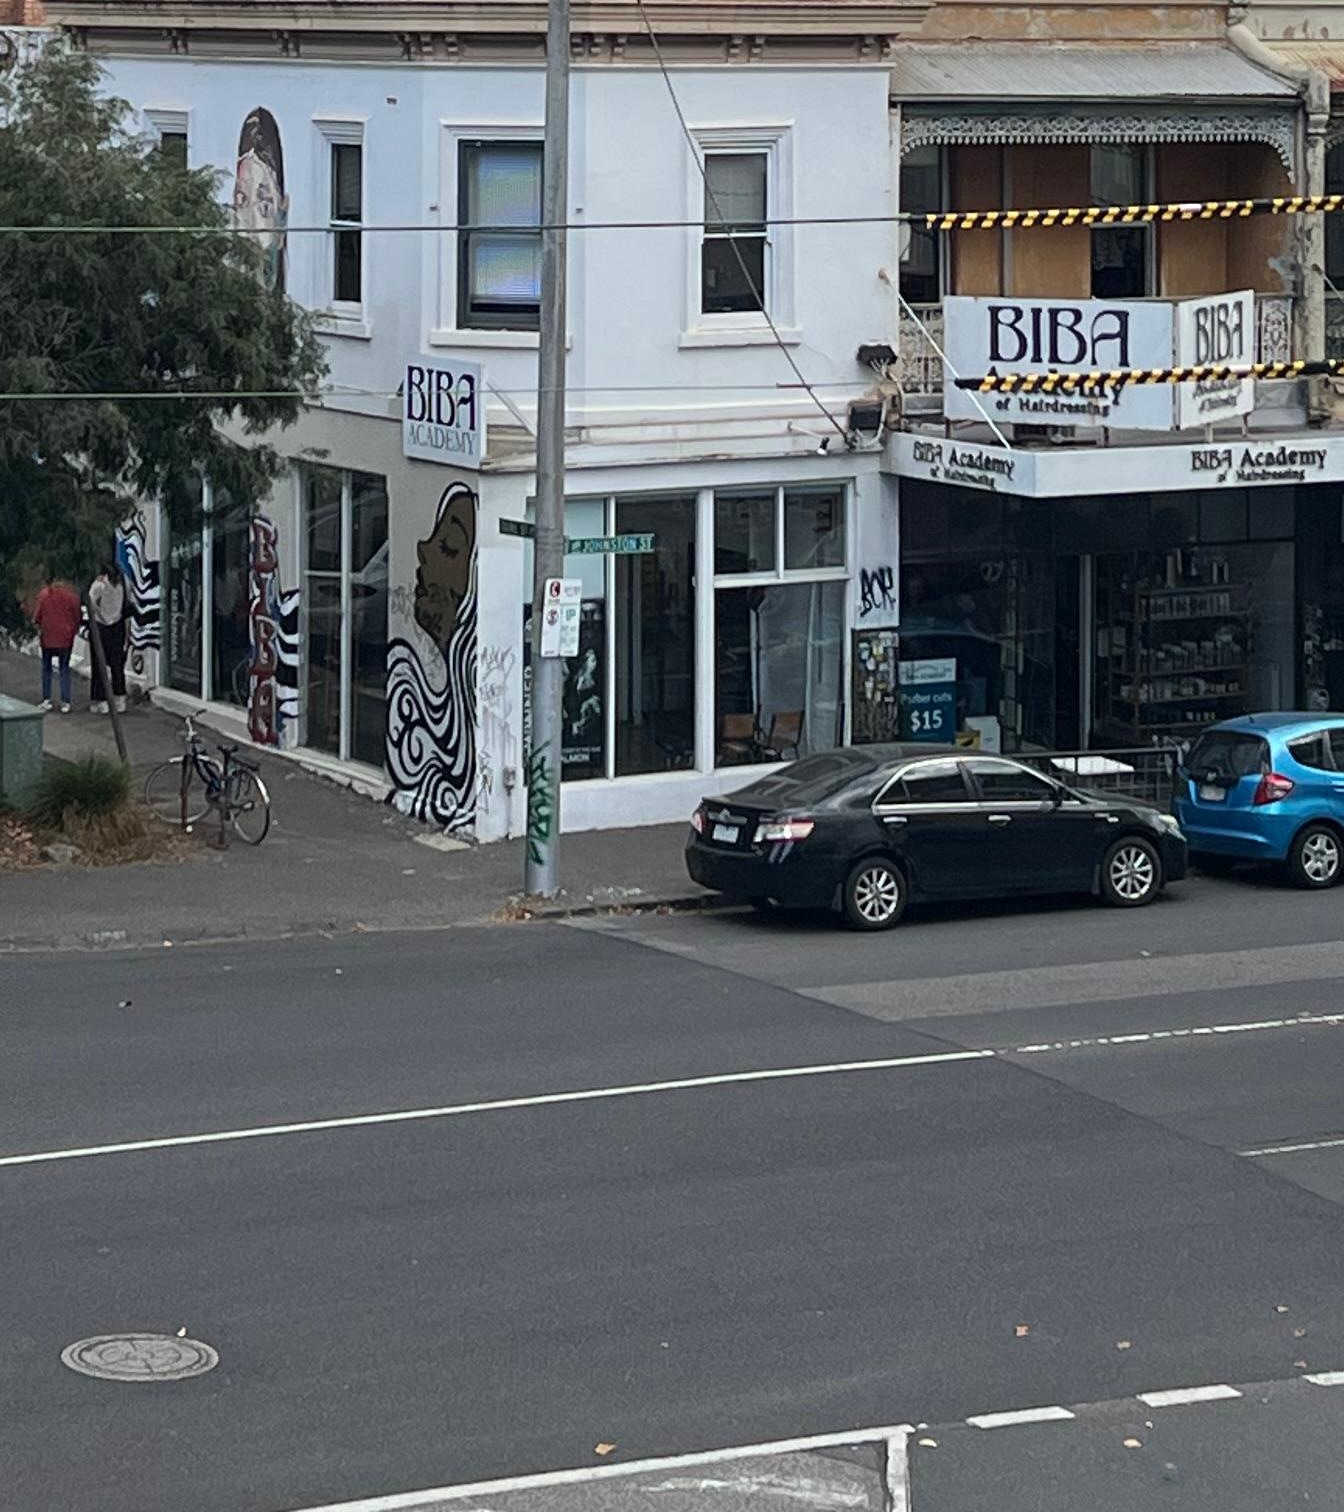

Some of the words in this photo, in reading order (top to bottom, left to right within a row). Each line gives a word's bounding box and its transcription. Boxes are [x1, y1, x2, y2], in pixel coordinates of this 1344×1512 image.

[987, 305, 1130, 368] BIBA
[1193, 300, 1244, 368] BIBA
[407, 365, 476, 431] BIBA
[996, 397, 1011, 412] of
[1018, 396, 1111, 418] Hairdressing
[408, 422, 478, 456] ACADEMY
[913, 440, 944, 468] BIBA
[949, 448, 1015, 481] Academy
[1191, 448, 1233, 471] BIBA
[1240, 446, 1327, 470] Academy
[640, 536, 653, 552] ST
[911, 709, 943, 733] $15
